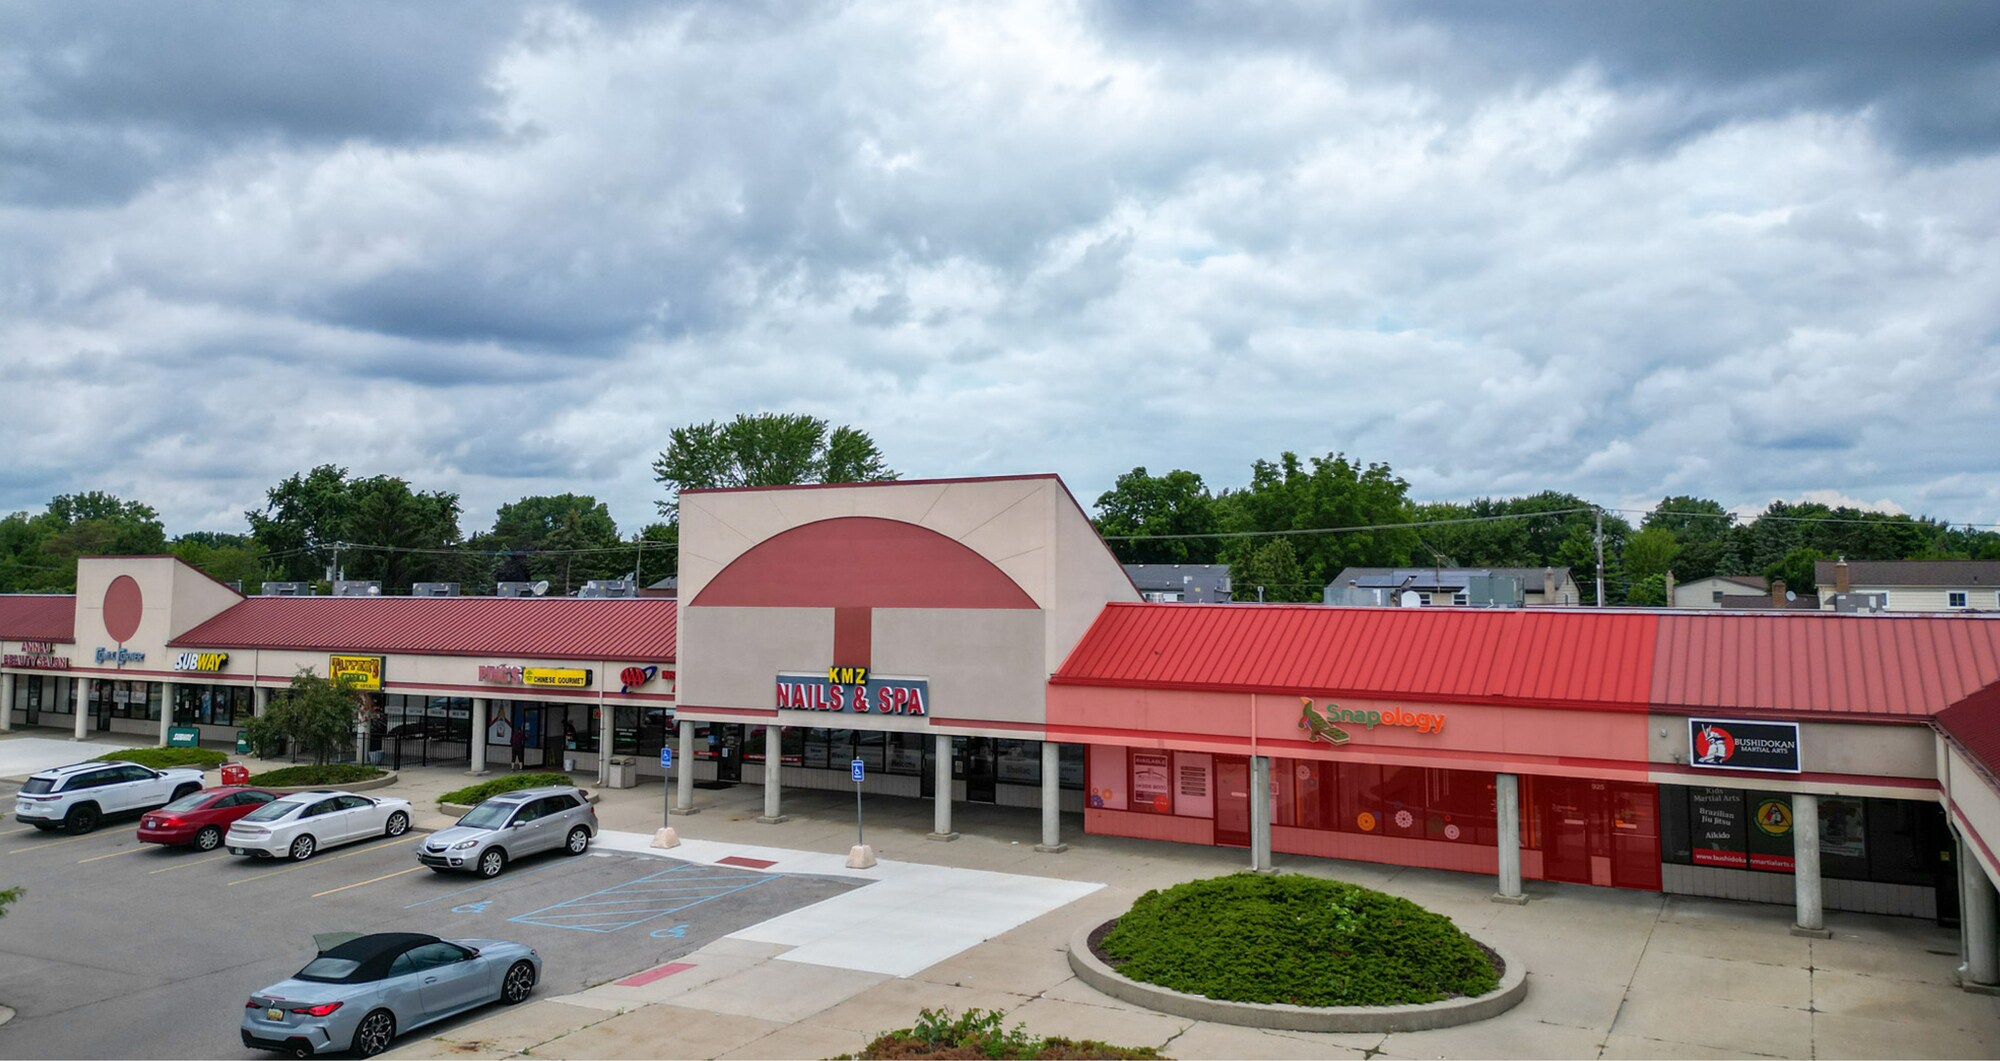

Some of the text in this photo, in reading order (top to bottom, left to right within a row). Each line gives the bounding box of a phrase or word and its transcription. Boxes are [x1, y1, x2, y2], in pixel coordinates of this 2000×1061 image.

[4, 654, 69, 668] BEAUTY SALON
[174, 652, 228, 671] SUBWAY
[534, 676, 556, 684] CHINESE
[558, 677, 584, 685] GOURMET
[622, 667, 645, 687] AAA
[828, 667, 866, 684] KMZ
[776, 683, 925, 715] NAILS & SPA
[1326, 703, 1445, 733] Snapology
[1735, 738, 1795, 748] BUSHIDOKAN
[1699, 807, 1734, 819] Brazilian
[1701, 815, 1731, 826] Jiu Jitsu
[1705, 831, 1730, 839] Aikido
[1696, 854, 1794, 868] www.bushidokanmartialarts.c
